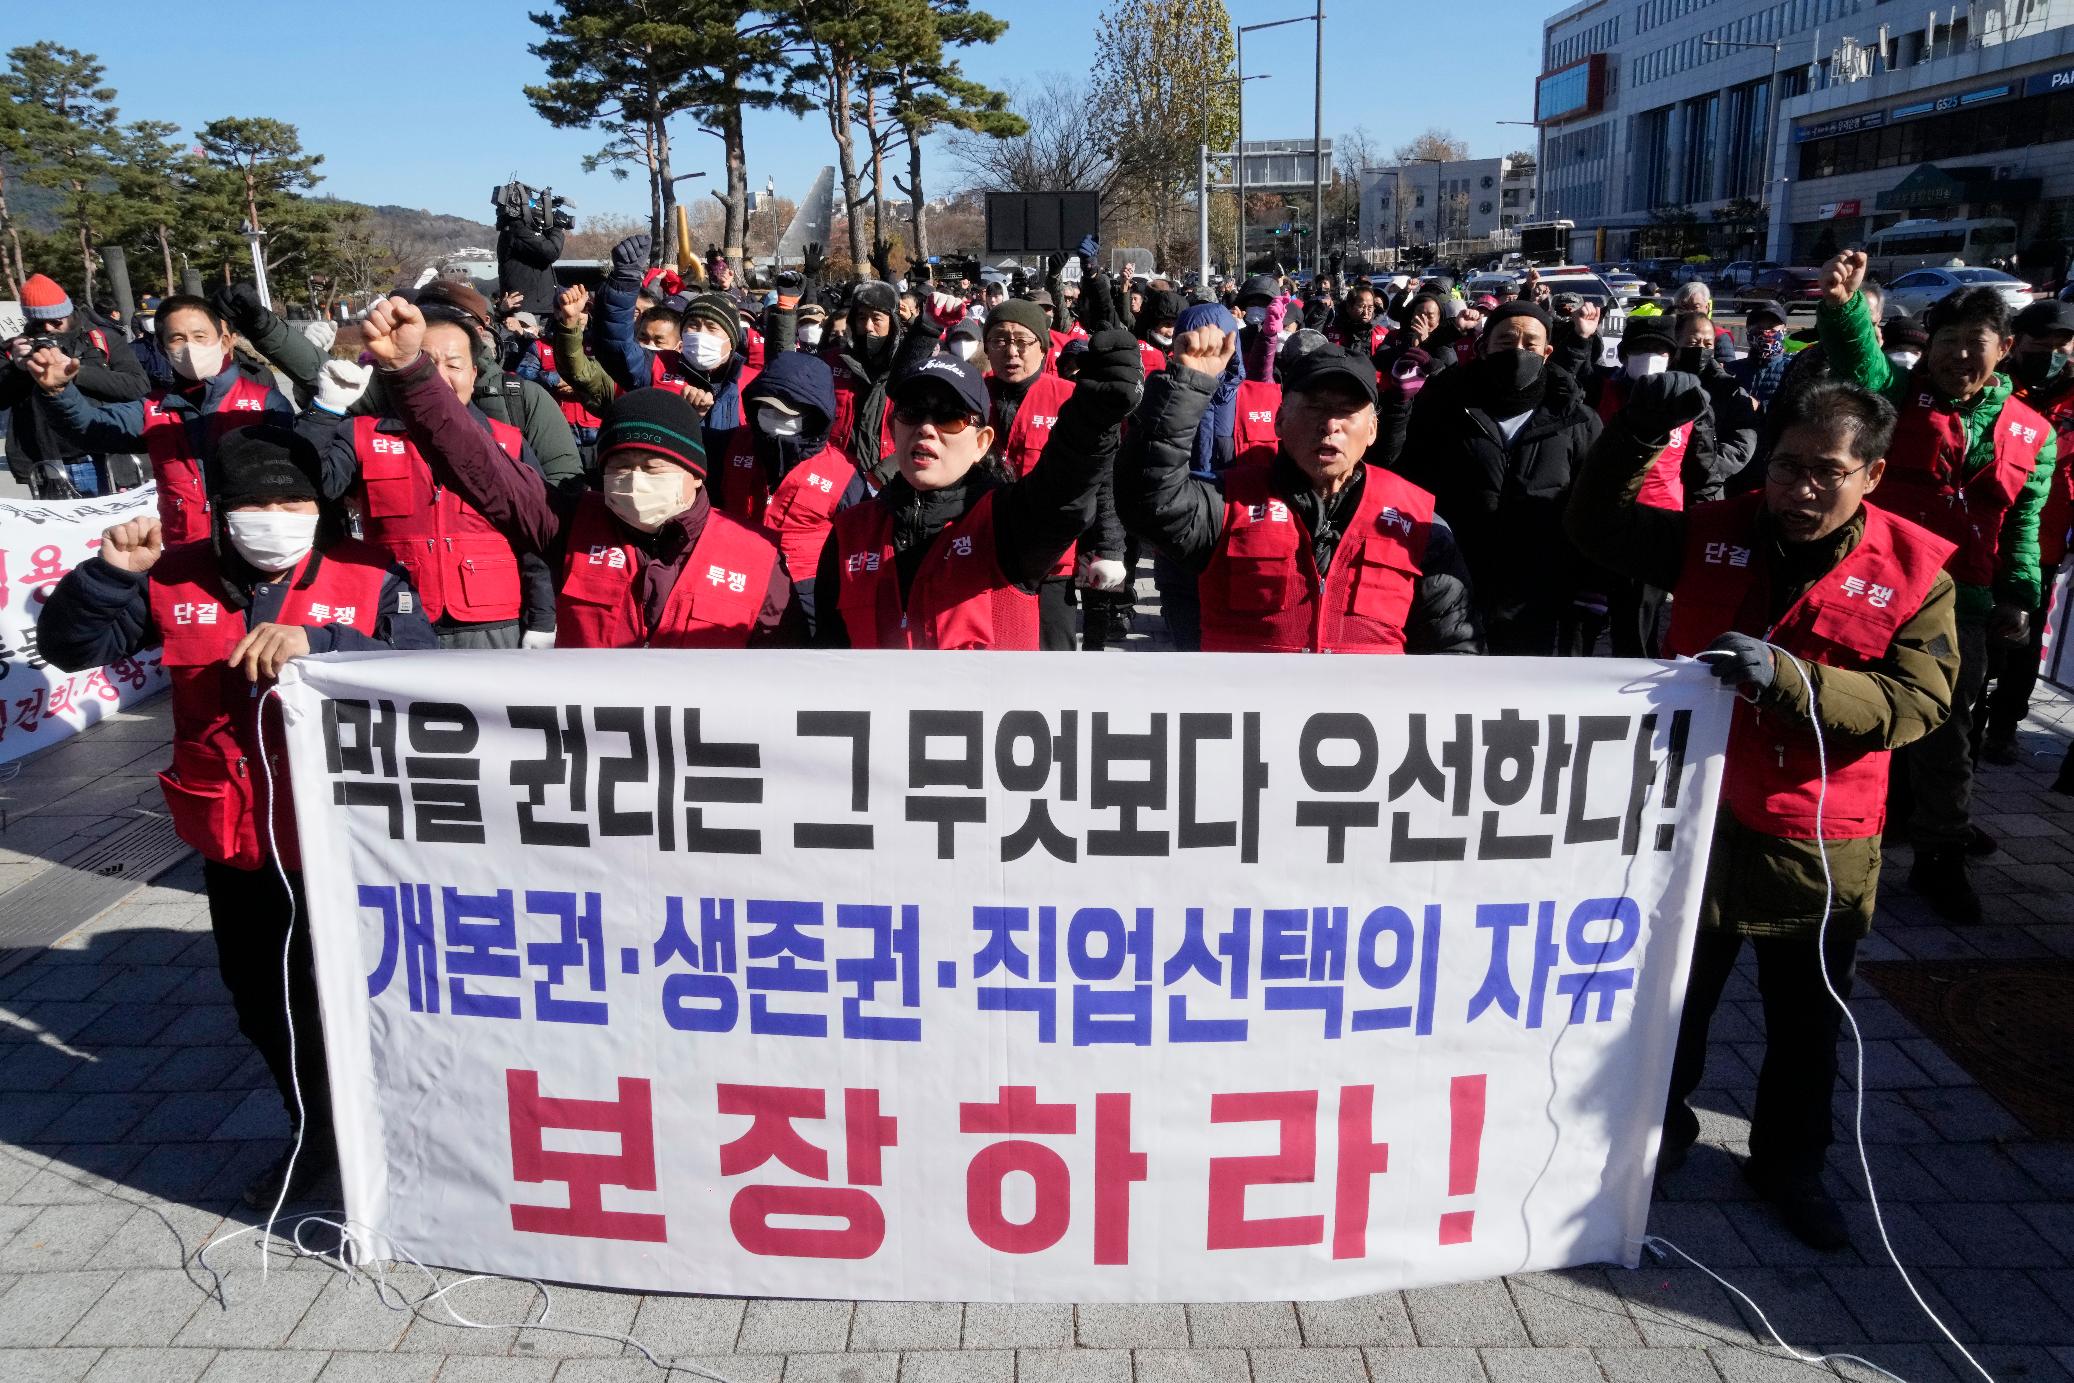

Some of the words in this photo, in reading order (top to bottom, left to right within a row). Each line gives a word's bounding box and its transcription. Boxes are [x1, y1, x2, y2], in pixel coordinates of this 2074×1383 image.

[2051, 70, 2074, 87] PA
[1248, 411, 1272, 423] 투쟁
[2009, 422, 2037, 444] 투쟁
[372, 438, 405, 455] 단결
[733, 455, 754, 468] 단결
[807, 473, 833, 493] 투쟁
[1248, 500, 1289, 523] 단결
[588, 544, 626, 569] 단결
[848, 551, 880, 572] 단결
[1704, 542, 1750, 567] 단결
[706, 565, 747, 593] 투쟁
[1840, 576, 1894, 608] 투쟁
[173, 602, 218, 625] 단결
[308, 602, 356, 625] 투쟁
[321, 698, 486, 844] 먹을
[506, 704, 764, 855] 권리는
[794, 710, 875, 850] 그
[905, 709, 1269, 863] 무엇보다
[1296, 708, 1693, 863] 우선한다!
[1466, 896, 1641, 1029] 자유
[505, 1068, 1487, 1265] 보장하라!
